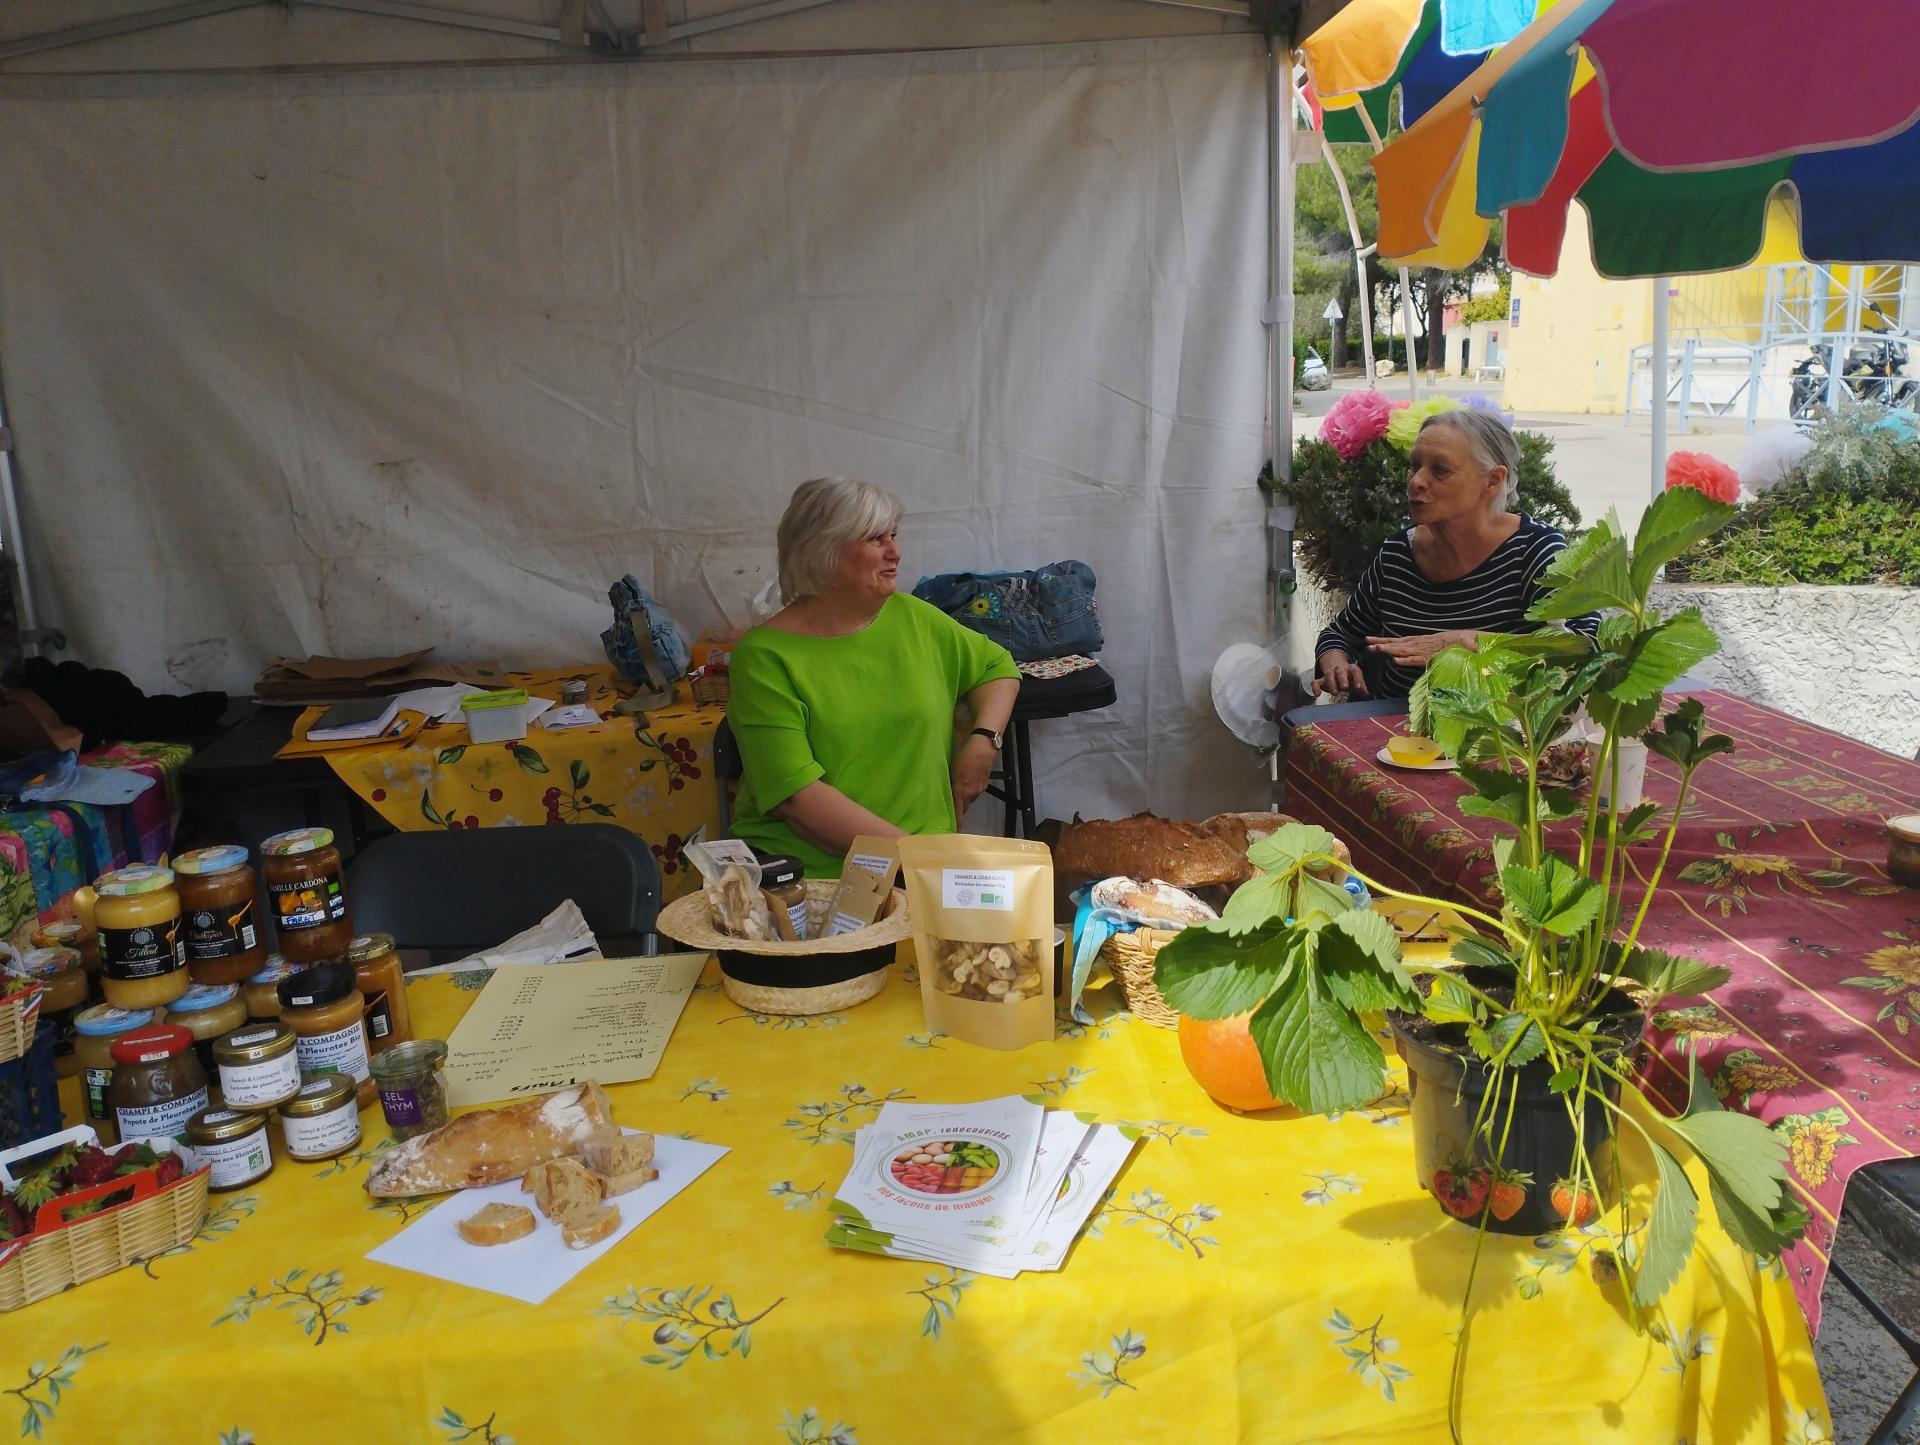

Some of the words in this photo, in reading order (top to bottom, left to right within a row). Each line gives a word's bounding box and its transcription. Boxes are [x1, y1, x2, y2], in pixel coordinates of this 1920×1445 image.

[294, 876, 328, 890] CARDONA
[305, 1041, 348, 1055] Pleurotes
[350, 1034, 361, 1044] Bio
[307, 1024, 360, 1047] COMPAGNIE
[119, 1106, 151, 1116] CHAMPI
[152, 1105, 160, 1113] &
[161, 1088, 207, 1112] COMPAGNIE
[384, 1092, 404, 1100] SEL
[123, 1117, 148, 1128] Popote
[149, 1117, 159, 1126] de
[160, 1105, 196, 1120] Pleurotes
[197, 1099, 206, 1109] Bio
[383, 1101, 413, 1111] THYM
[953, 1195, 995, 1211] manger
